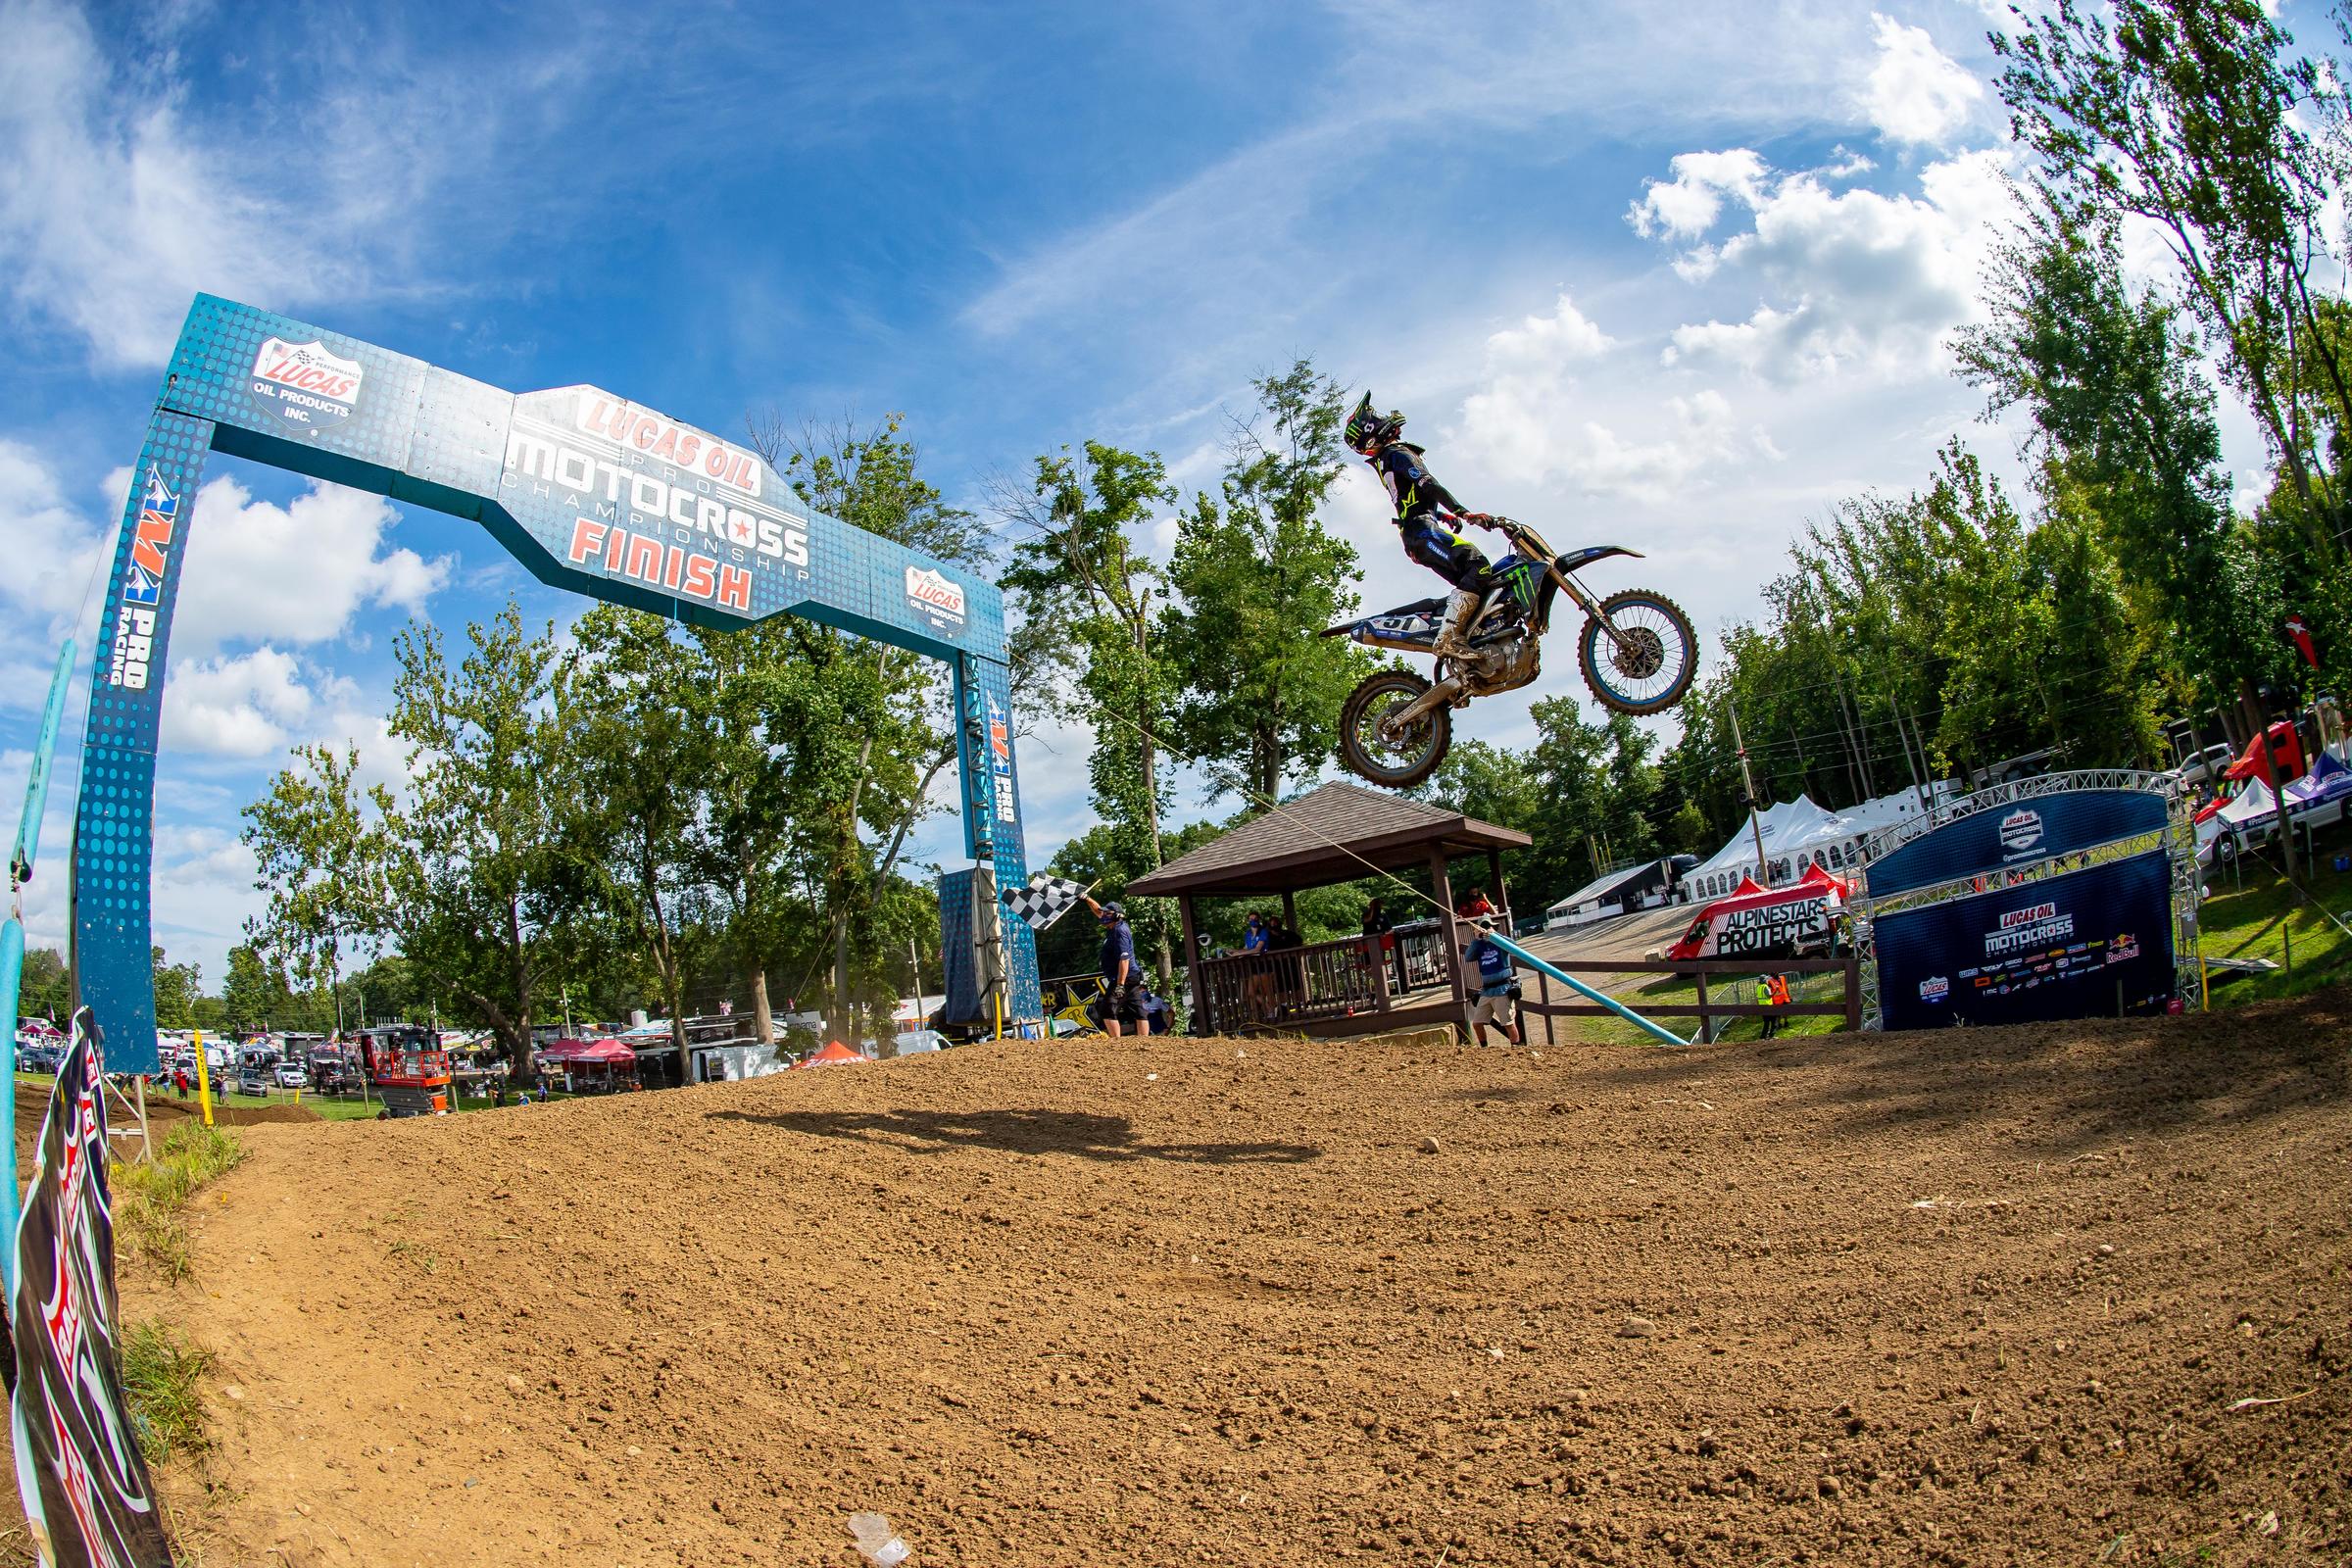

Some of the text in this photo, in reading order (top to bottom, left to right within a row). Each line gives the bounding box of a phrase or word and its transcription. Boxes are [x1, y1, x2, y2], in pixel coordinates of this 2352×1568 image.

[264, 361, 357, 397] LUCAS
[253, 382, 351, 417] OIL PRODUCTS
[283, 407, 311, 422] INC.
[584, 400, 755, 491] LUCAS OIL
[630, 455, 711, 493] PRO
[507, 440, 808, 567] MOTOCROSS
[123, 463, 180, 606] AMA
[502, 473, 809, 581] CHAMPIONSHIP
[568, 516, 753, 611] FINISH
[909, 600, 964, 625] OIL PRODUCTS
[913, 583, 961, 610] LUCAS
[931, 617, 947, 629] INC.
[110, 607, 132, 686] RACING
[122, 608, 157, 689] PRO
[1002, 776, 1015, 823] PRO
[2002, 824, 2040, 837] MOTOCROSS
[2005, 815, 2024, 826] LUCAS
[2002, 847, 2047, 862] @promotocross
[1726, 897, 1828, 930] ALPINESTARS
[2003, 904, 2054, 927] LUCAS OIL
[2017, 920, 2043, 930] PRO
[1717, 915, 1820, 955] PROTECTS
[1985, 918, 2074, 953] MOTOCROSS
[1985, 932, 2075, 958] CHAMPIONSHIP
